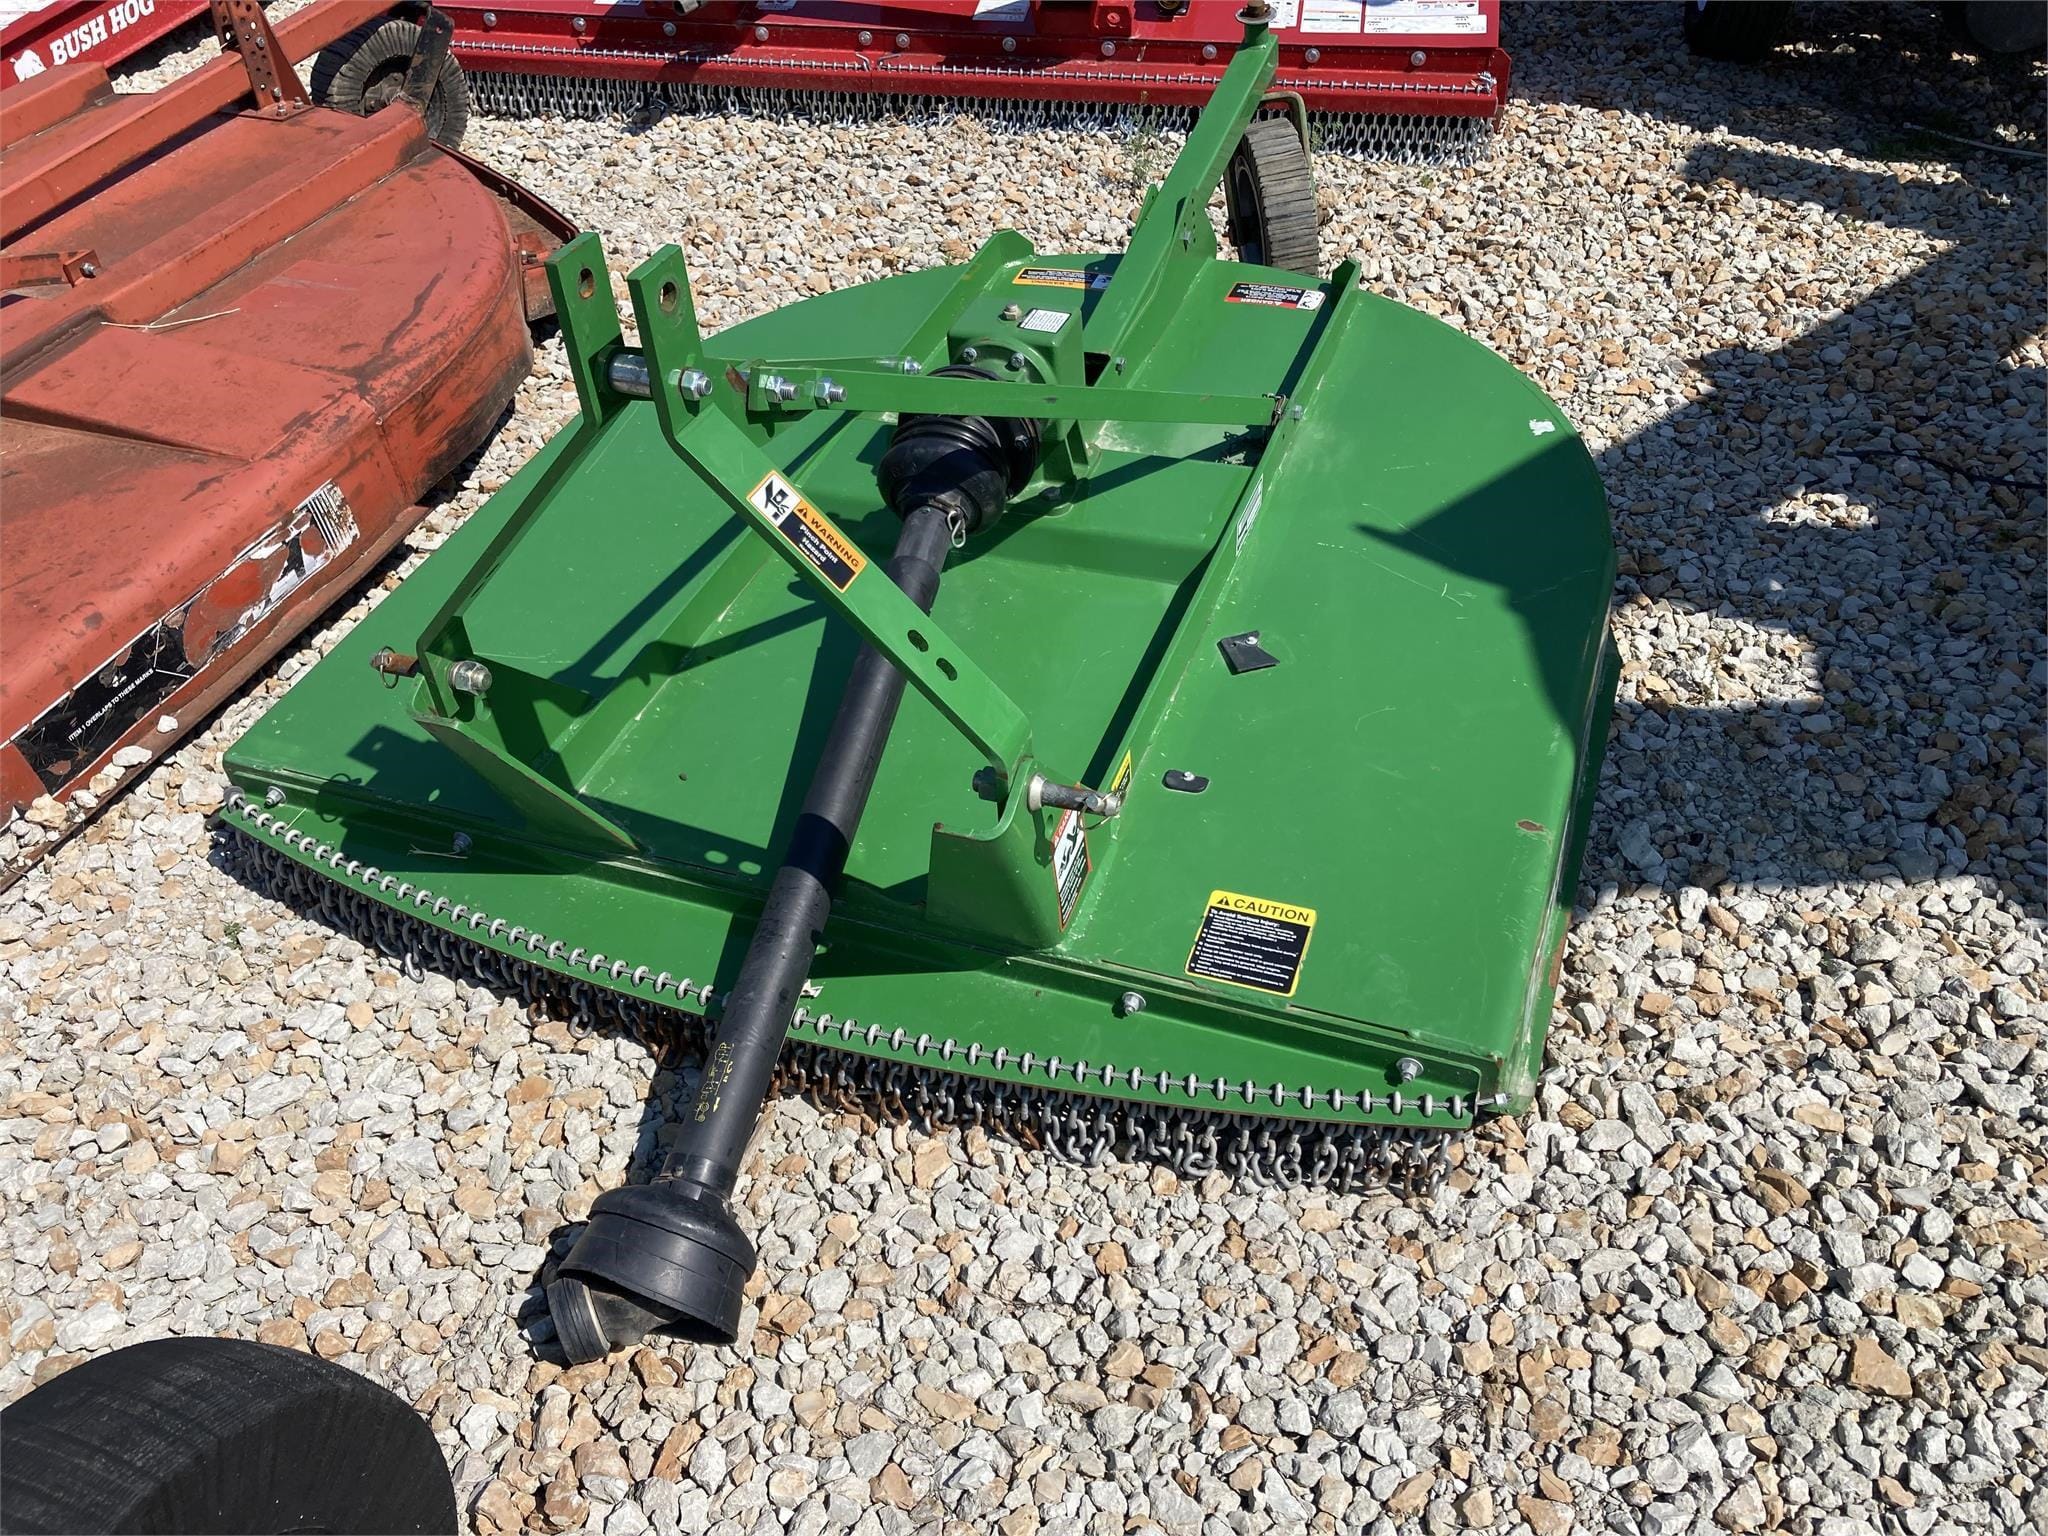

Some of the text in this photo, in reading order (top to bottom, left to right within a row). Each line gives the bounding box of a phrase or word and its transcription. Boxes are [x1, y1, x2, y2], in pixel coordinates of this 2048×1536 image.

[50, 0, 155, 66] BUSH HOG
[799, 524, 838, 564] Pinch Point
[801, 536, 827, 563] Hazard
[811, 518, 859, 567] WARNING
[68, 727, 83, 742] ITEM
[86, 701, 113, 727] OVERLAPS
[111, 696, 120, 705] TO
[118, 682, 136, 699] THESE
[134, 668, 154, 685] MARKS
[1234, 899, 1309, 922] CAUTION
